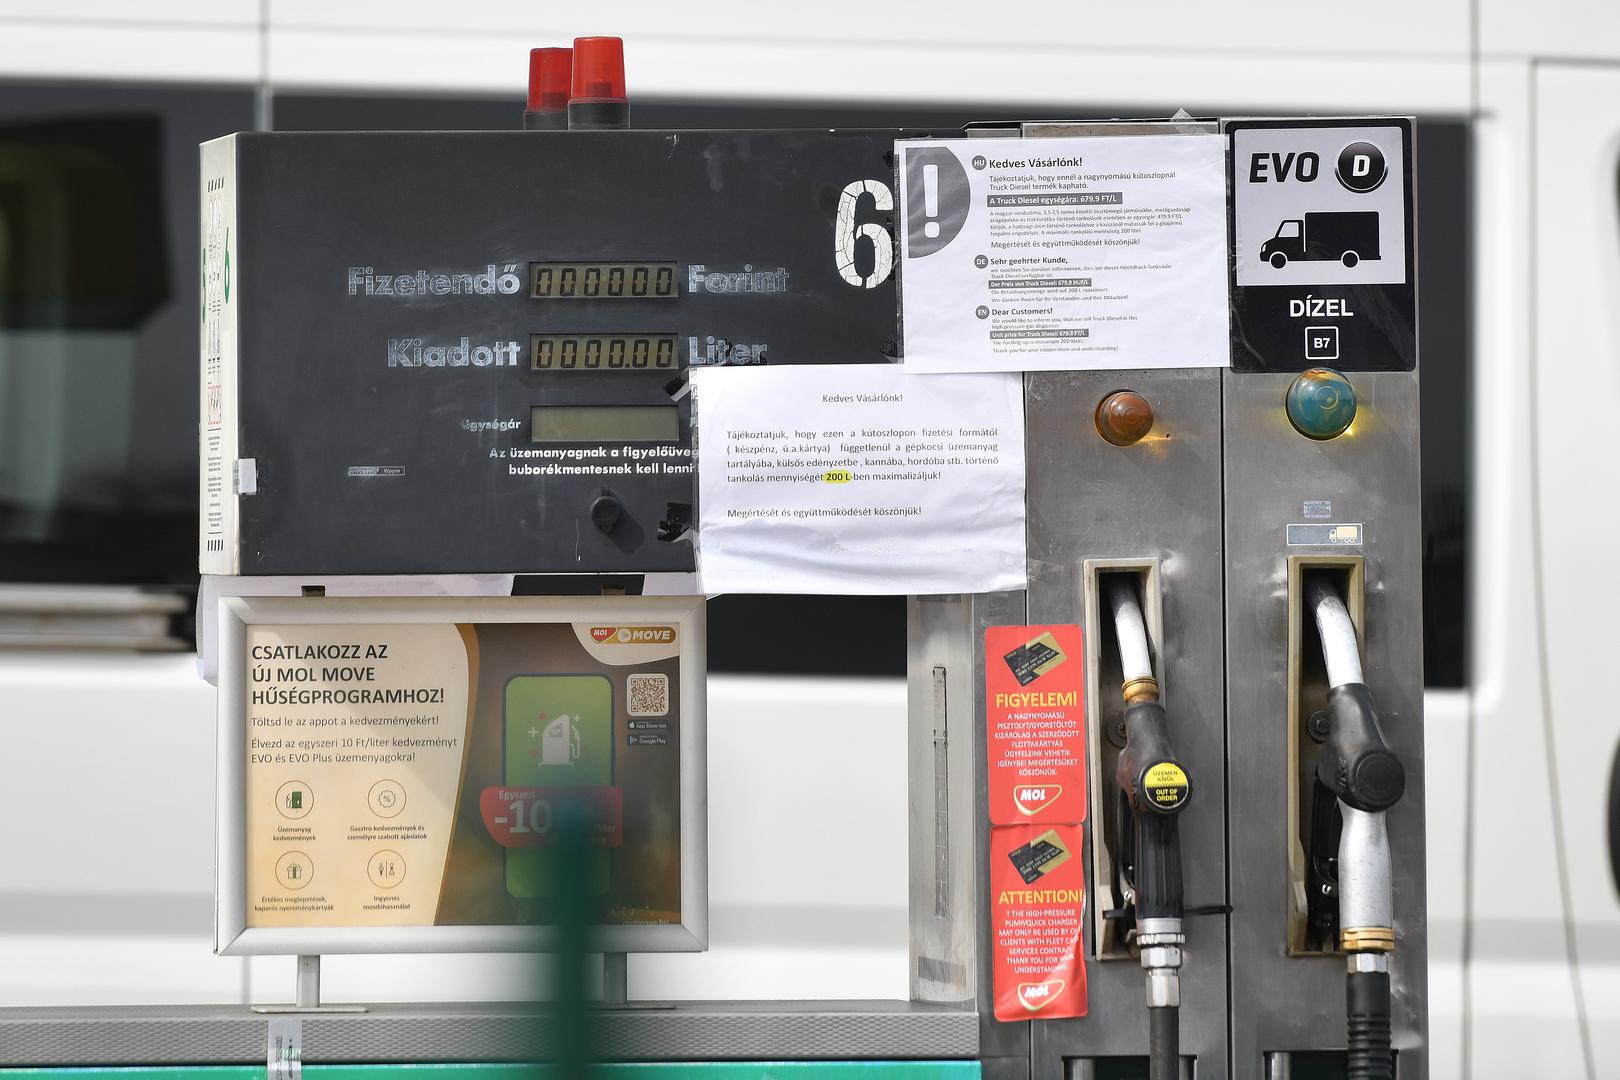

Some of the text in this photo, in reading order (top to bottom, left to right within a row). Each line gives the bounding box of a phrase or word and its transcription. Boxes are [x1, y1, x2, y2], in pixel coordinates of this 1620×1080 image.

[990, 157, 1082, 168] Kedves Vásárlónk!
[1249, 152, 1370, 183] EVO D
[1084, 172, 1130, 181] nagynyomású
[1059, 182, 1088, 190] kapható.
[1041, 196, 1078, 205] egységára:
[835, 180, 893, 288] 6
[991, 241, 1030, 249] Megértését
[1042, 240, 1102, 248] együttműködését
[348, 264, 520, 295] Fizetendő
[536, 267, 673, 296] 000000
[688, 264, 789, 292] Forint
[1290, 295, 1353, 317] DÍZEL
[1314, 337, 1330, 348] B7
[388, 337, 520, 367] Kiadott
[688, 336, 767, 364] Liter
[823, 393, 903, 403] Kedves Vásárlónk!
[727, 430, 789, 440] Tájékoztatjuk,
[795, 429, 817, 440] hogy
[862, 428, 915, 439] kútoszlopon
[922, 428, 953, 437] fizetési
[959, 427, 998, 436] formától
[490, 448, 505, 458] Az
[510, 447, 606, 459] üzemanyagnak
[735, 444, 778, 454] készpénz,
[783, 443, 831, 454] ü.a.kártya)
[840, 443, 890, 454] függetlenül
[906, 442, 943, 453] gépkocsi
[948, 443, 998, 453] üzemanyag
[727, 458, 774, 468] tartályába,
[807, 457, 858, 468] edényzetbe
[865, 457, 905, 467] kannába,
[908, 456, 945, 465] hordóba
[947, 456, 963, 464] stb.
[965, 455, 999, 465] történő
[509, 464, 631, 474] buborékmentesnek
[636, 463, 658, 473] kell
[727, 473, 765, 482] tankolás
[767, 472, 823, 483] mennyiségét
[826, 472, 843, 481] 200
[873, 471, 941, 481] maximalizáljuk!
[727, 506, 921, 518] Megértését és együttműködését köszönjük!
[633, 630, 671, 640] MOVE
[252, 645, 388, 659] CSATLAKOZZ AZ
[252, 665, 375, 682] ÚJ MOL MOVE
[252, 686, 444, 705] HŰSÉGPROGRAMHOZ!
[996, 692, 1077, 707] FIGYELEM!
[251, 718, 281, 726] Töltsd
[285, 718, 292, 726] le
[309, 718, 338, 727] appot
[350, 716, 439, 727] kedvezményekért!
[1014, 712, 1065, 720] NAGYNYOMÁSÚ
[995, 731, 1030, 739] KIZÁRÓLAG
[251, 737, 457, 750] Élvezd az egyszeri 10 Ft/liter kedvezményt
[1012, 739, 1063, 747] FLOTTAKÁRTYÁS
[251, 754, 272, 763] EVO
[276, 753, 286, 763] és
[289, 754, 309, 763] EVO
[313, 753, 332, 762] Plus
[1020, 789, 1046, 800] MOL
[278, 826, 311, 834] Üzemanyag
[273, 834, 316, 842] kedvezmények
[374, 895, 399, 903] Ingyenes
[999, 889, 1082, 904] ATTENTION!
[1025, 986, 1049, 998] MOL
